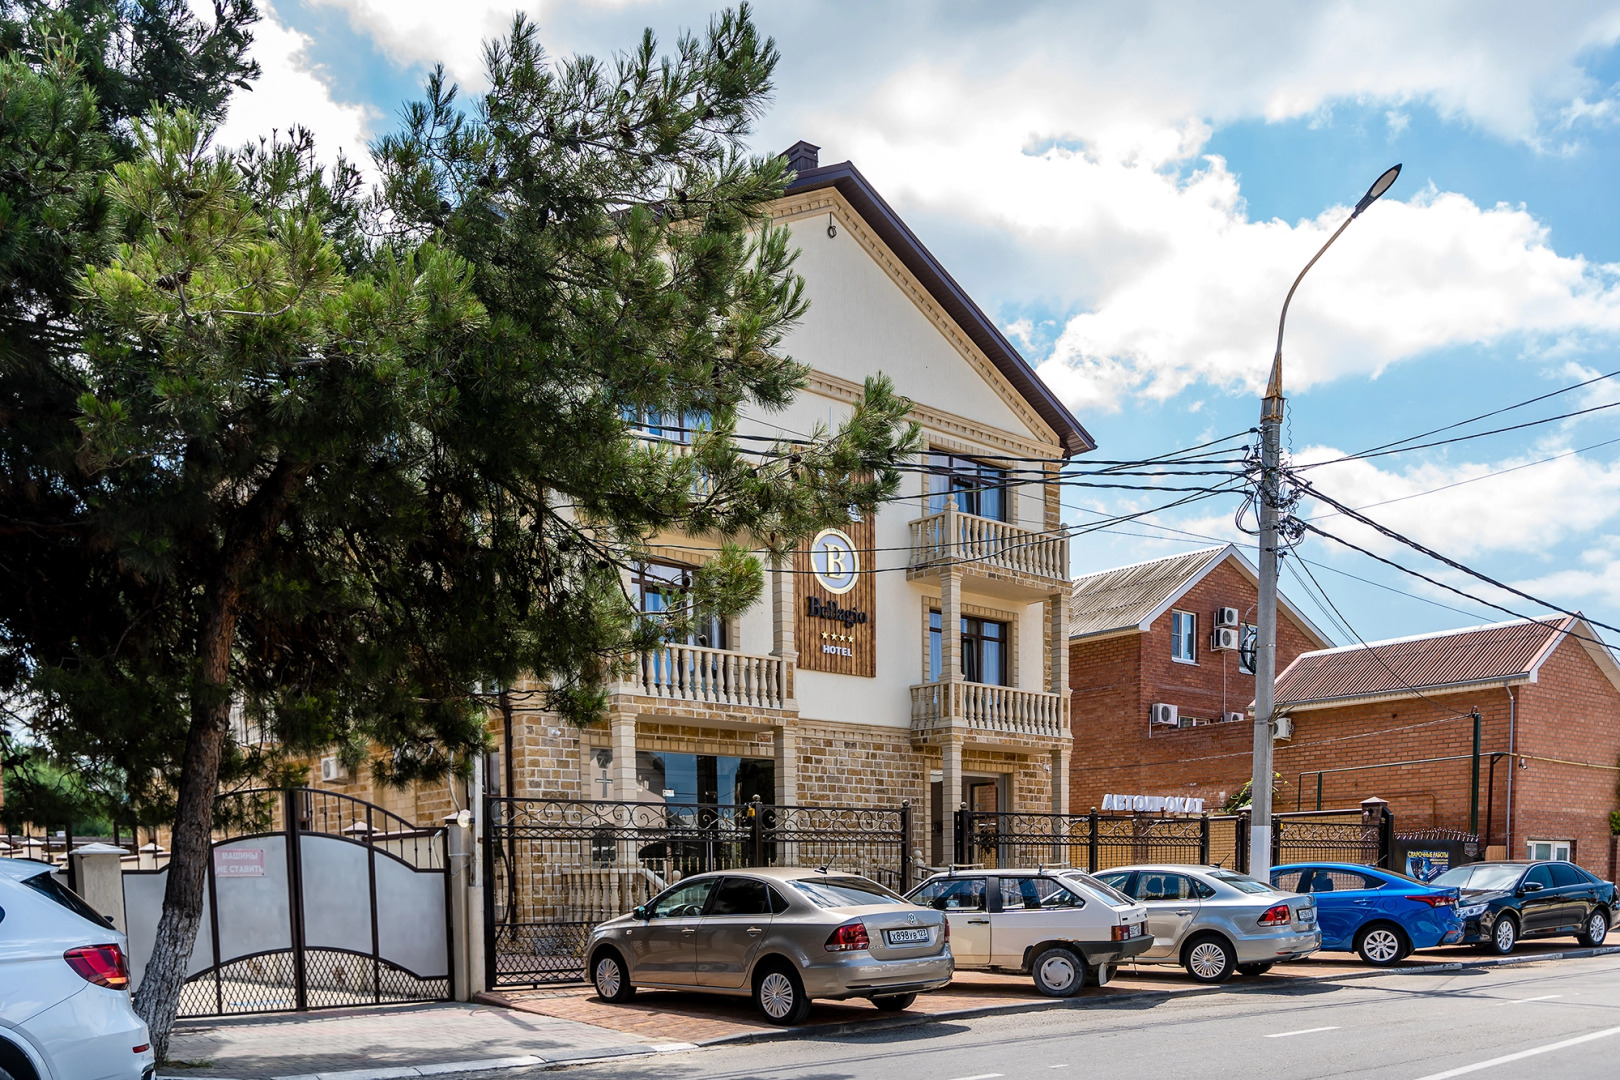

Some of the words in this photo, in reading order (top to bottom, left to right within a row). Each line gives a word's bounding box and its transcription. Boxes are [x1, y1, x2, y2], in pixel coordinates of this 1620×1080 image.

[823, 542, 846, 579] B
[807, 596, 867, 628] Bellagio
[822, 645, 852, 657] HOTEL
[1101, 794, 1205, 813] АВТОПРОКАТ
[222, 852, 258, 860] МАШИНЫ
[217, 865, 227, 873] НЕ
[230, 865, 264, 873] СТАВИТЬ
